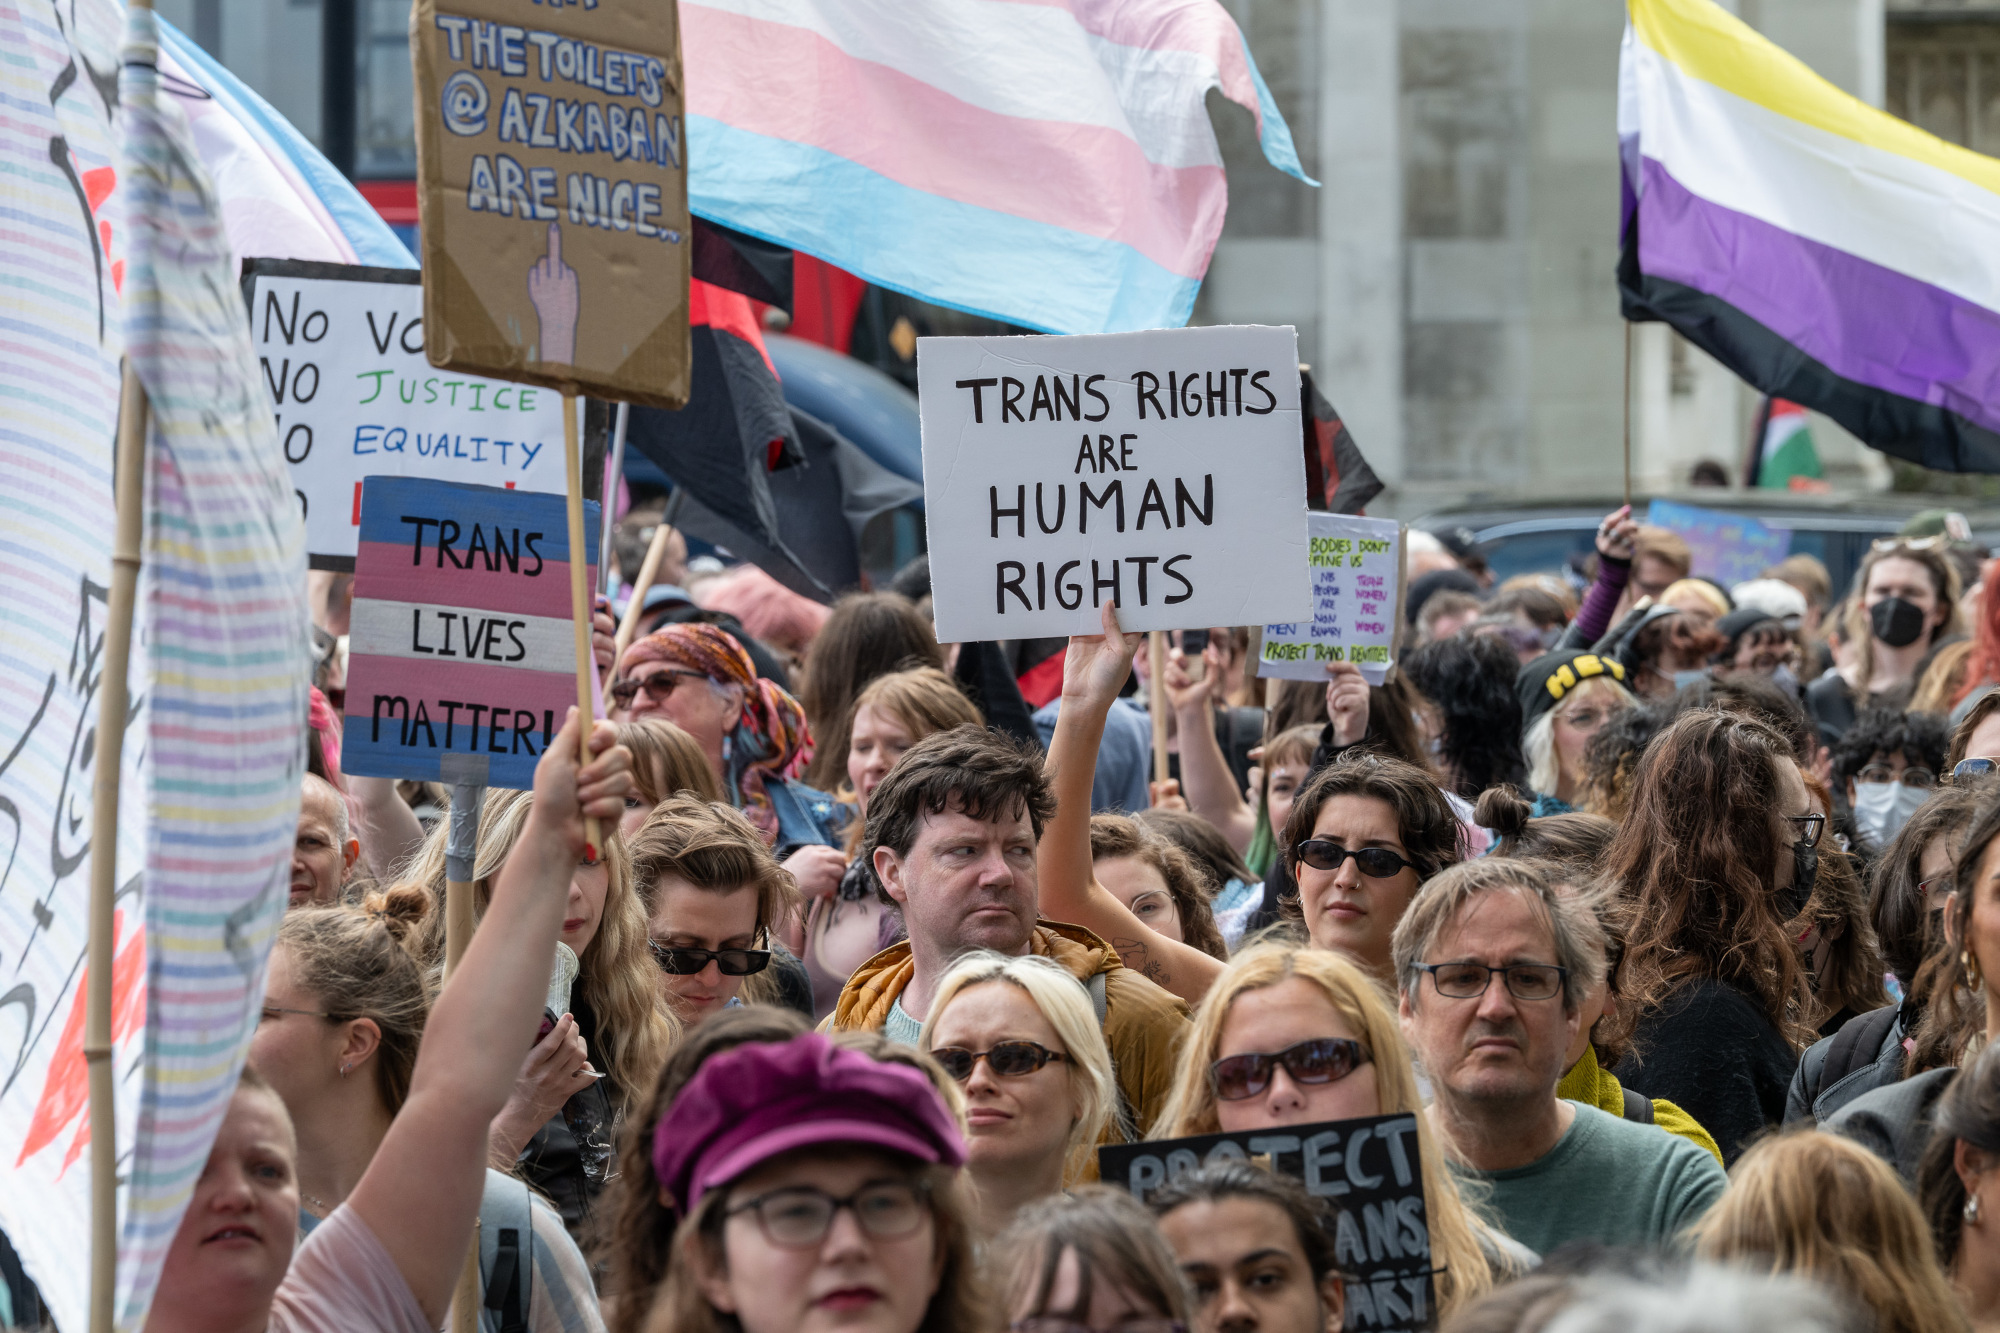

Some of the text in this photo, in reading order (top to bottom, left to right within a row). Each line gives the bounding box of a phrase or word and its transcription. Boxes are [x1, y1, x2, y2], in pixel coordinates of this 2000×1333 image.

[441, 70, 681, 169] @ AZKABAN
[468, 153, 559, 221] ARE
[356, 369, 538, 412] JUSTICE
[955, 368, 1277, 424] TRANS RIGHTS
[353, 425, 543, 470] EQUALITY
[1074, 434, 1138, 474] ARE
[989, 474, 1214, 538] HUMAN
[400, 515, 544, 577] TRANS
[1311, 537, 1391, 554] BODIES DON'T
[1350, 555, 1363, 568] US
[996, 554, 1193, 614] RIGHTS
[412, 609, 526, 662] LIVES
[1266, 641, 1311, 660] PROTECT
[1267, 624, 1296, 635] MEN
[371, 695, 554, 756] MATTER!
